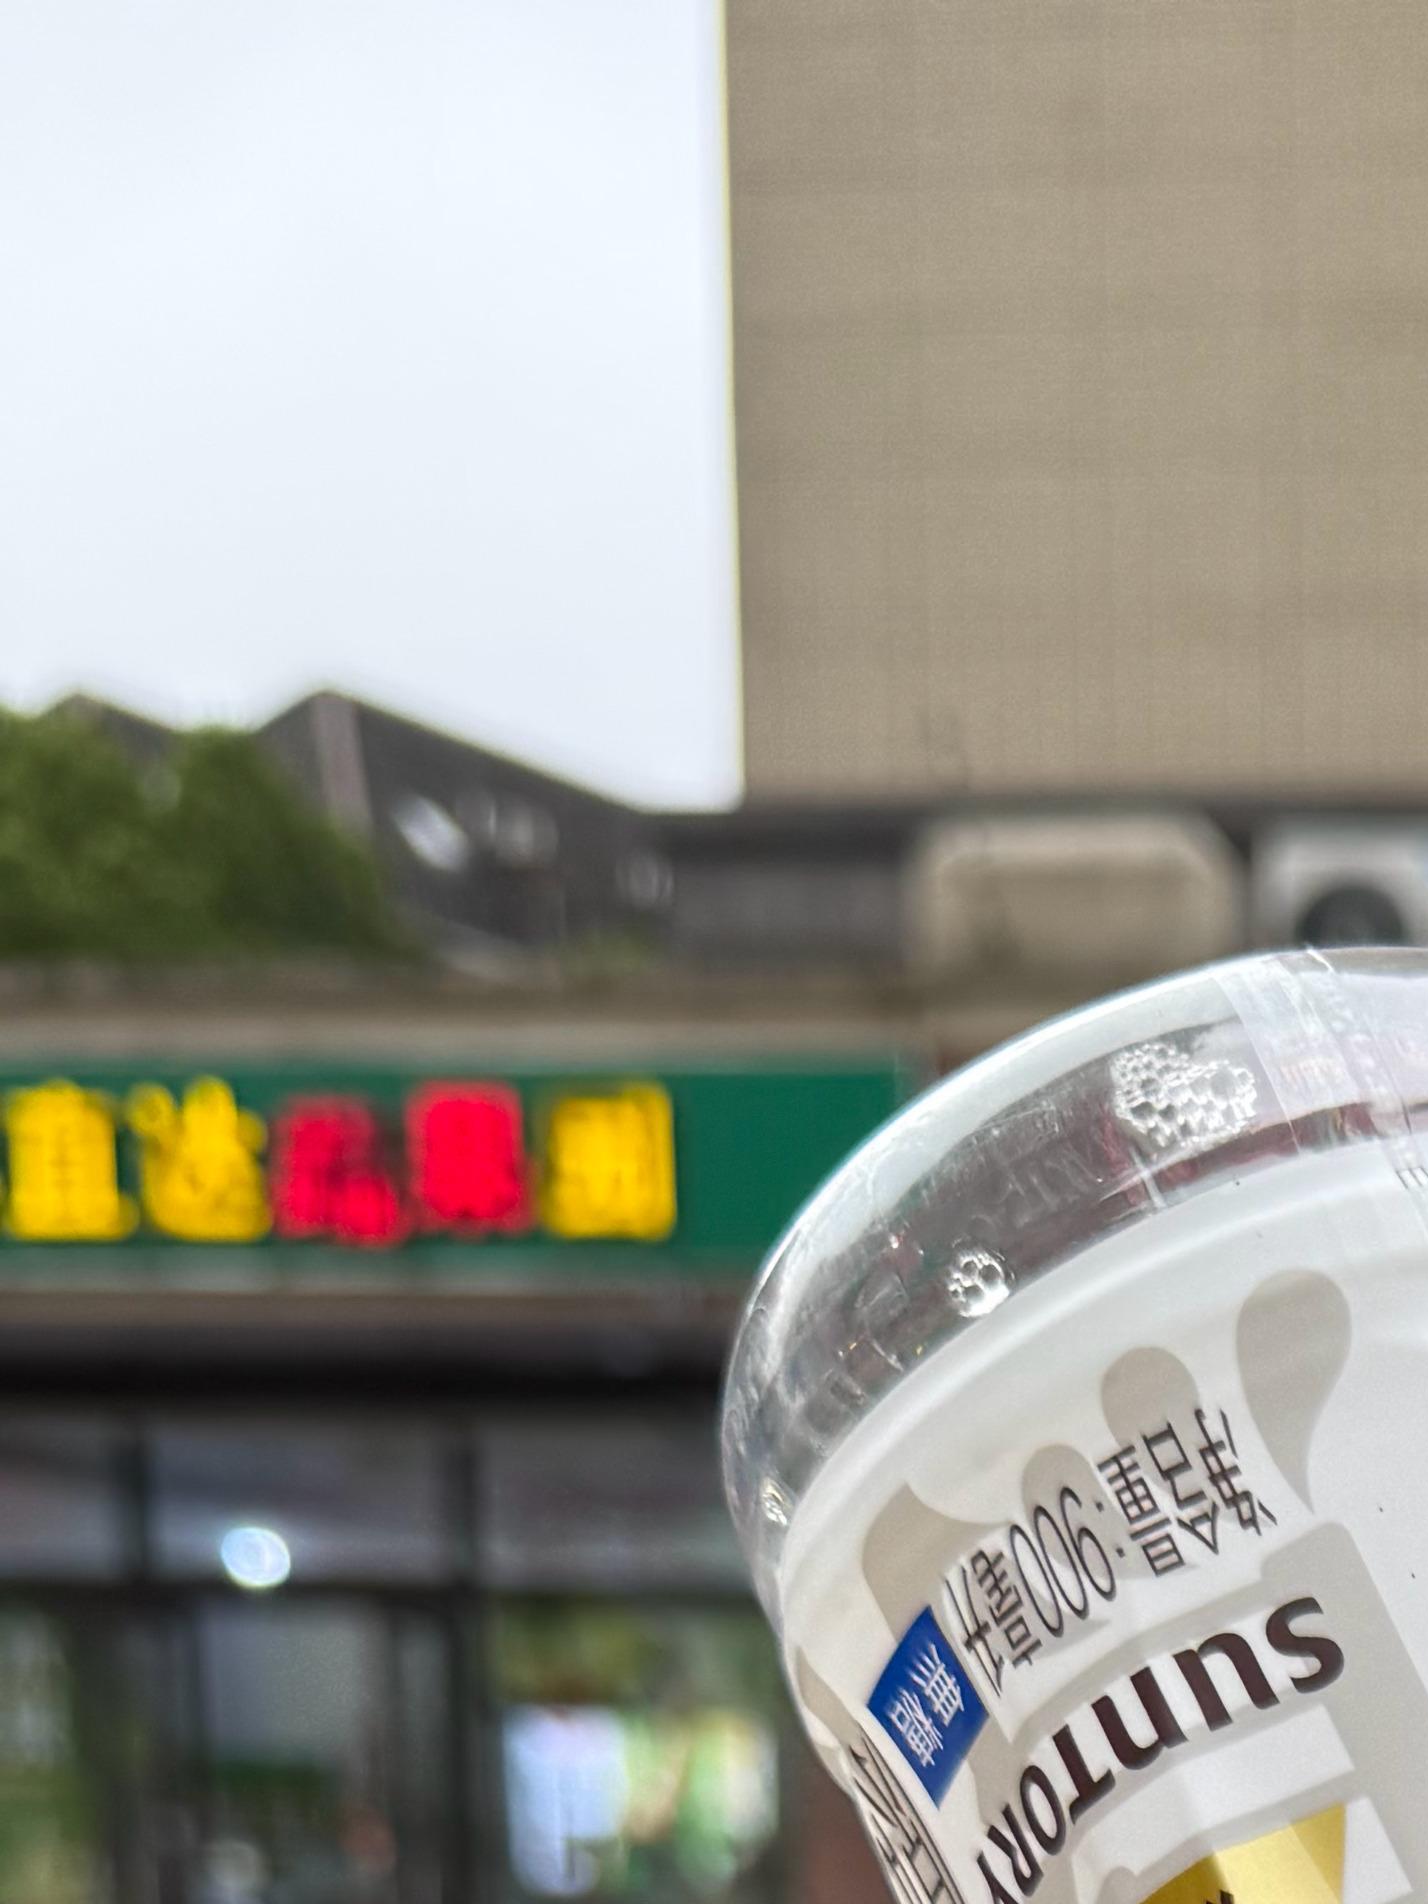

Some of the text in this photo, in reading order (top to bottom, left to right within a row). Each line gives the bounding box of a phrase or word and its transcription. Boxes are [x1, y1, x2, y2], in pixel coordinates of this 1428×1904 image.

[943, 1407, 1278, 1698] 净含量:900毫升
[884, 1640, 966, 1768] 無糖
